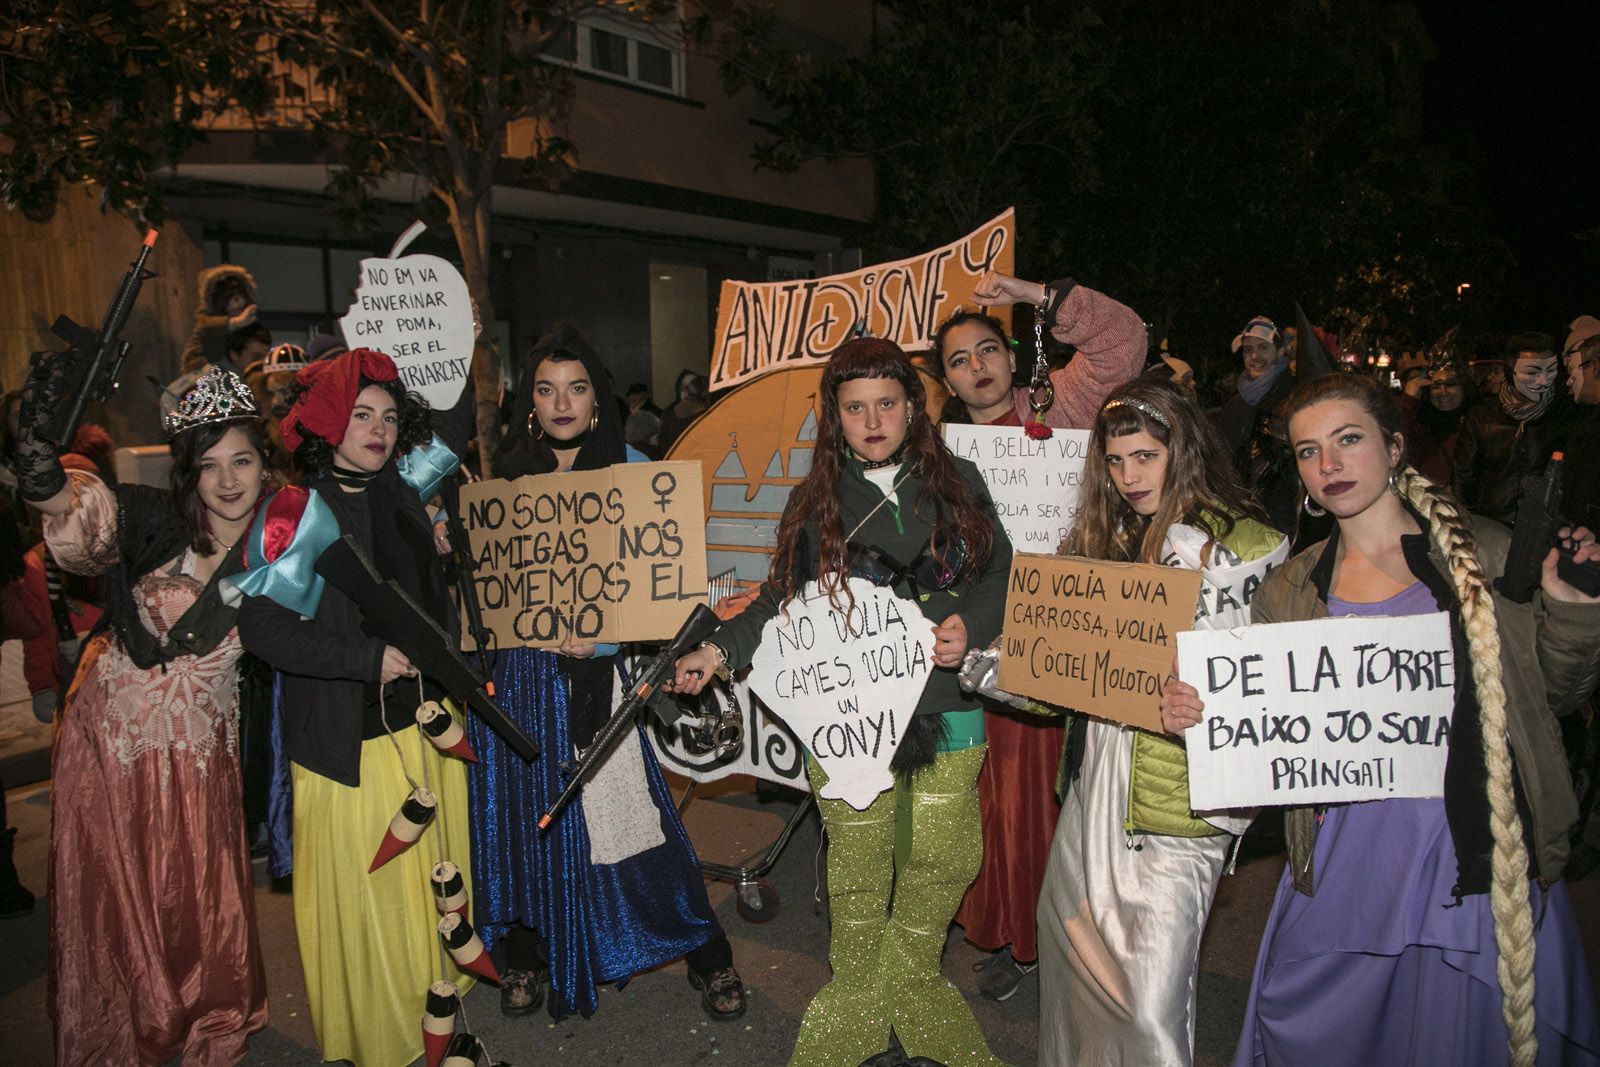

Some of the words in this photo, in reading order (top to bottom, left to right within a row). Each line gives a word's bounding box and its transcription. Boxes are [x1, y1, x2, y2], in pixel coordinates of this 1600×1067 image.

[368, 268, 389, 286] NO
[397, 268, 415, 285] EM
[419, 268, 438, 283] VA
[356, 319, 384, 335] CAP
[397, 317, 442, 333] POMA,
[392, 341, 422, 358] SER
[428, 339, 447, 353] EL
[956, 437, 980, 458] LA
[993, 436, 1046, 459] BELLA
[1058, 439, 1088, 459] VOL
[982, 468, 1028, 487] ATJAR
[469, 497, 506, 531] NO
[512, 487, 625, 530] SOMOS
[1037, 503, 1061, 518] SER
[478, 528, 589, 572] AMIGAS
[619, 519, 684, 560] NOS
[1025, 530, 1050, 543] UNA
[651, 562, 708, 602] EL
[1012, 567, 1041, 595] NO
[1121, 579, 1168, 606] UNA
[513, 600, 604, 641] COÑO
[776, 616, 815, 658] NO
[1013, 603, 1108, 637] CARROSSA,
[1007, 637, 1025, 658] UN
[775, 656, 855, 699] CAMES,
[1207, 654, 1265, 697] DE
[1287, 645, 1341, 693] LA
[1353, 643, 1453, 693] TORRE
[837, 695, 859, 715] UN
[811, 709, 896, 759] CONY!
[1324, 710, 1372, 744] JO
[1377, 711, 1451, 747] SOLA
[1270, 756, 1395, 792] PRINGAT!
